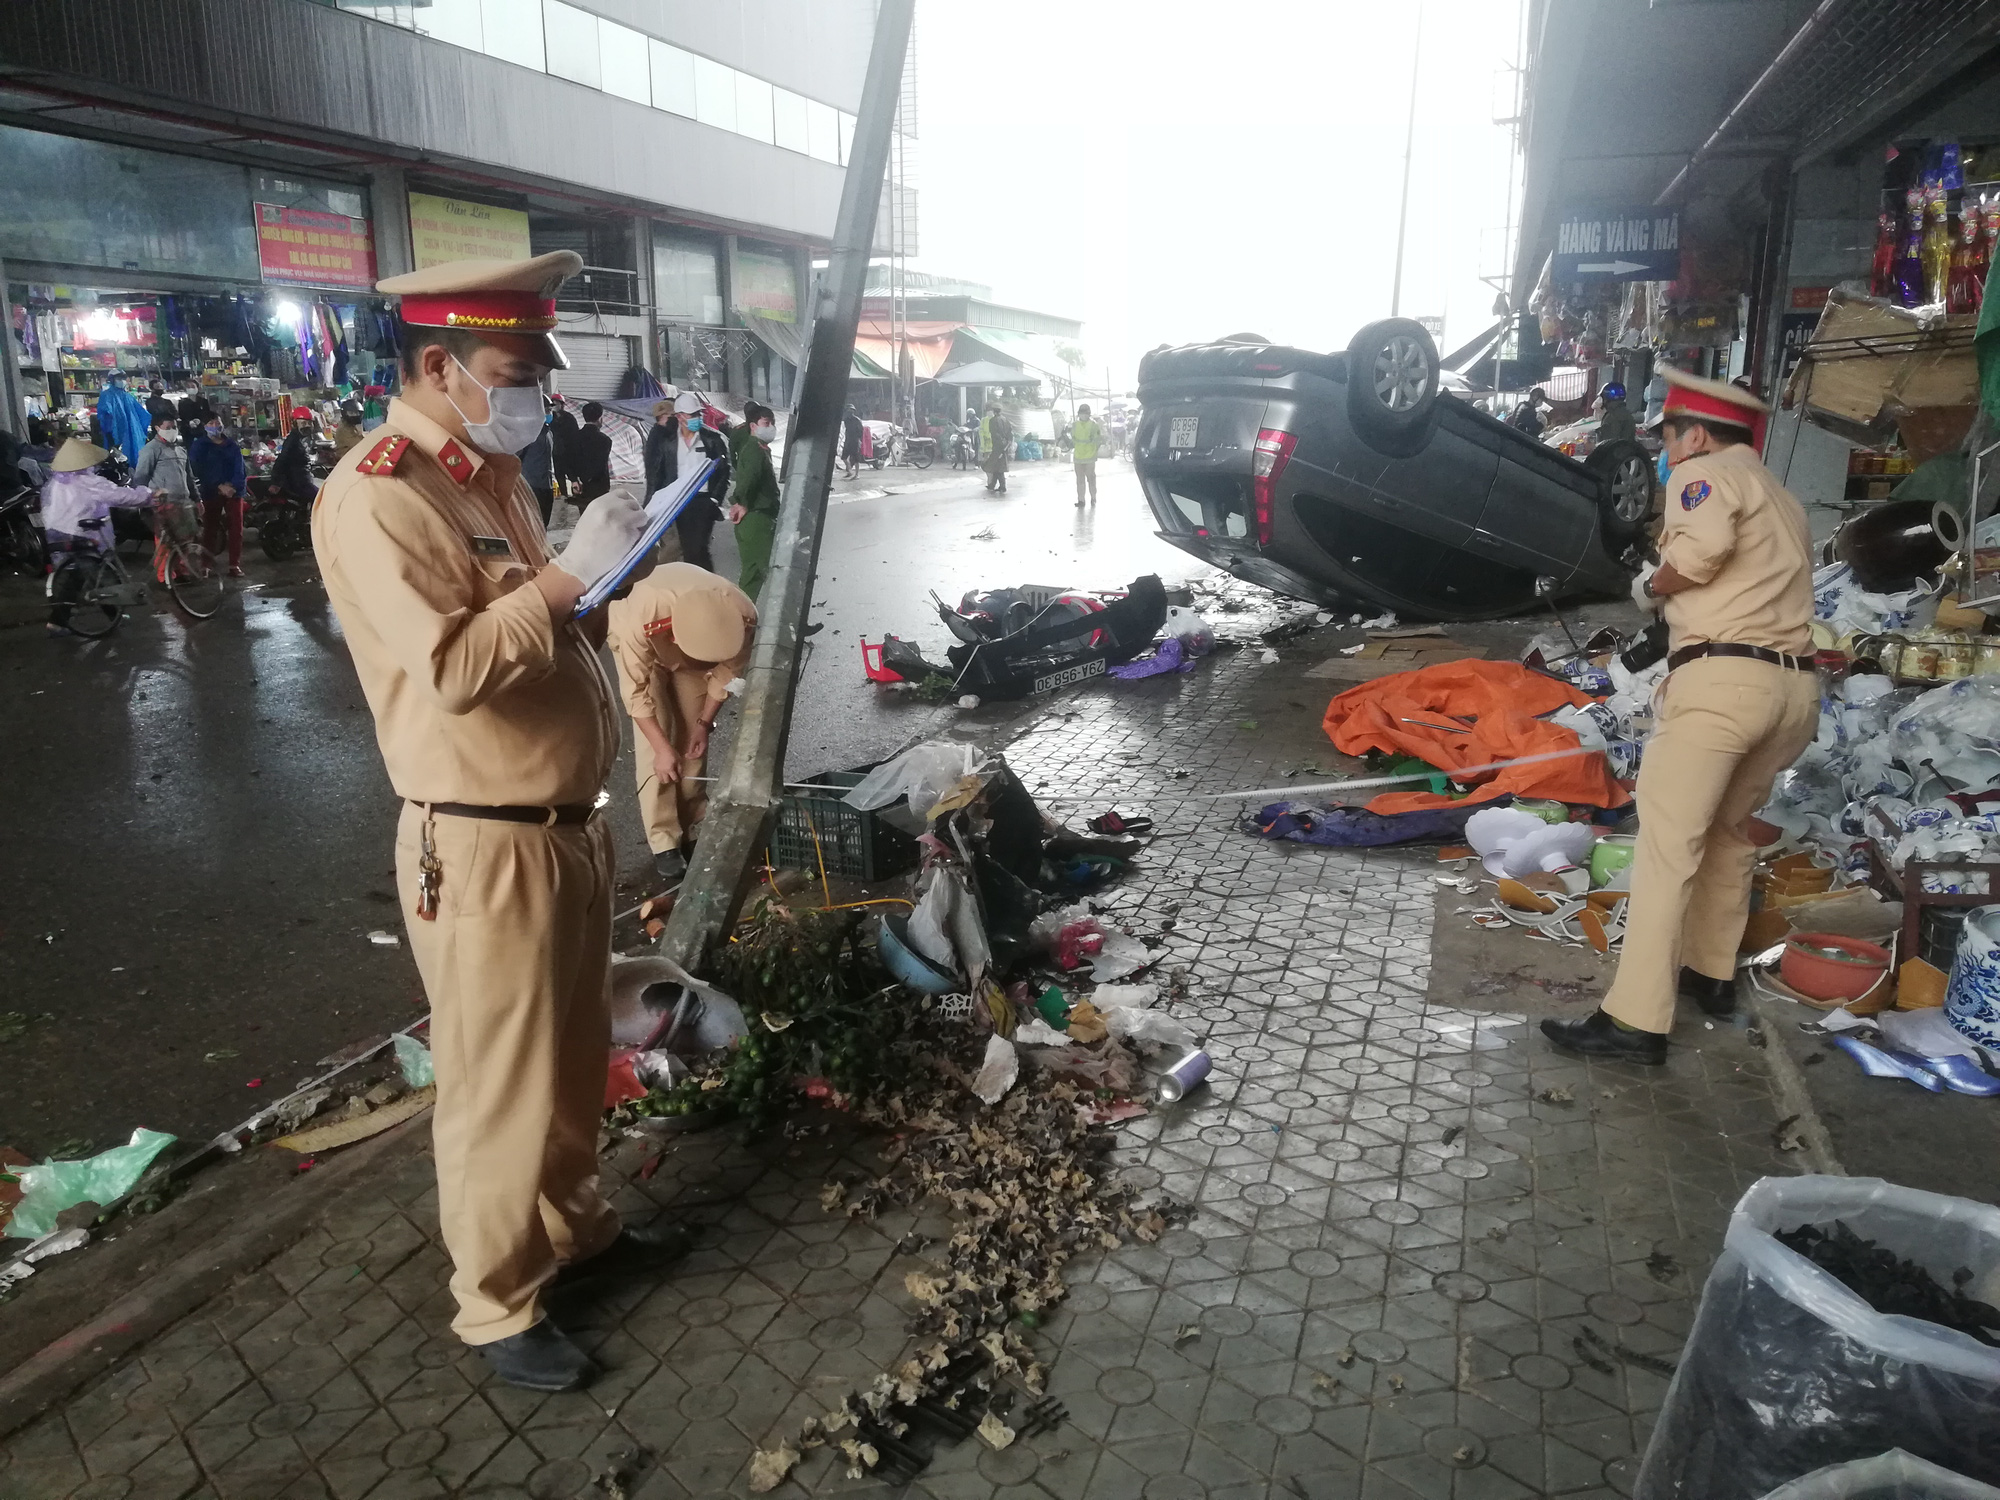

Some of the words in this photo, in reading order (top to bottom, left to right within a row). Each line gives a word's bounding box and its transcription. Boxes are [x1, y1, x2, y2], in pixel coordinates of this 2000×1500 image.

[1558, 216, 1602, 254] HÀNG
[1606, 214, 1650, 253] VÀNG
[1172, 418, 1197, 432] 958.30
[1175, 433, 1190, 446] 29A
[1037, 660, 1104, 692] 29A-958.30
